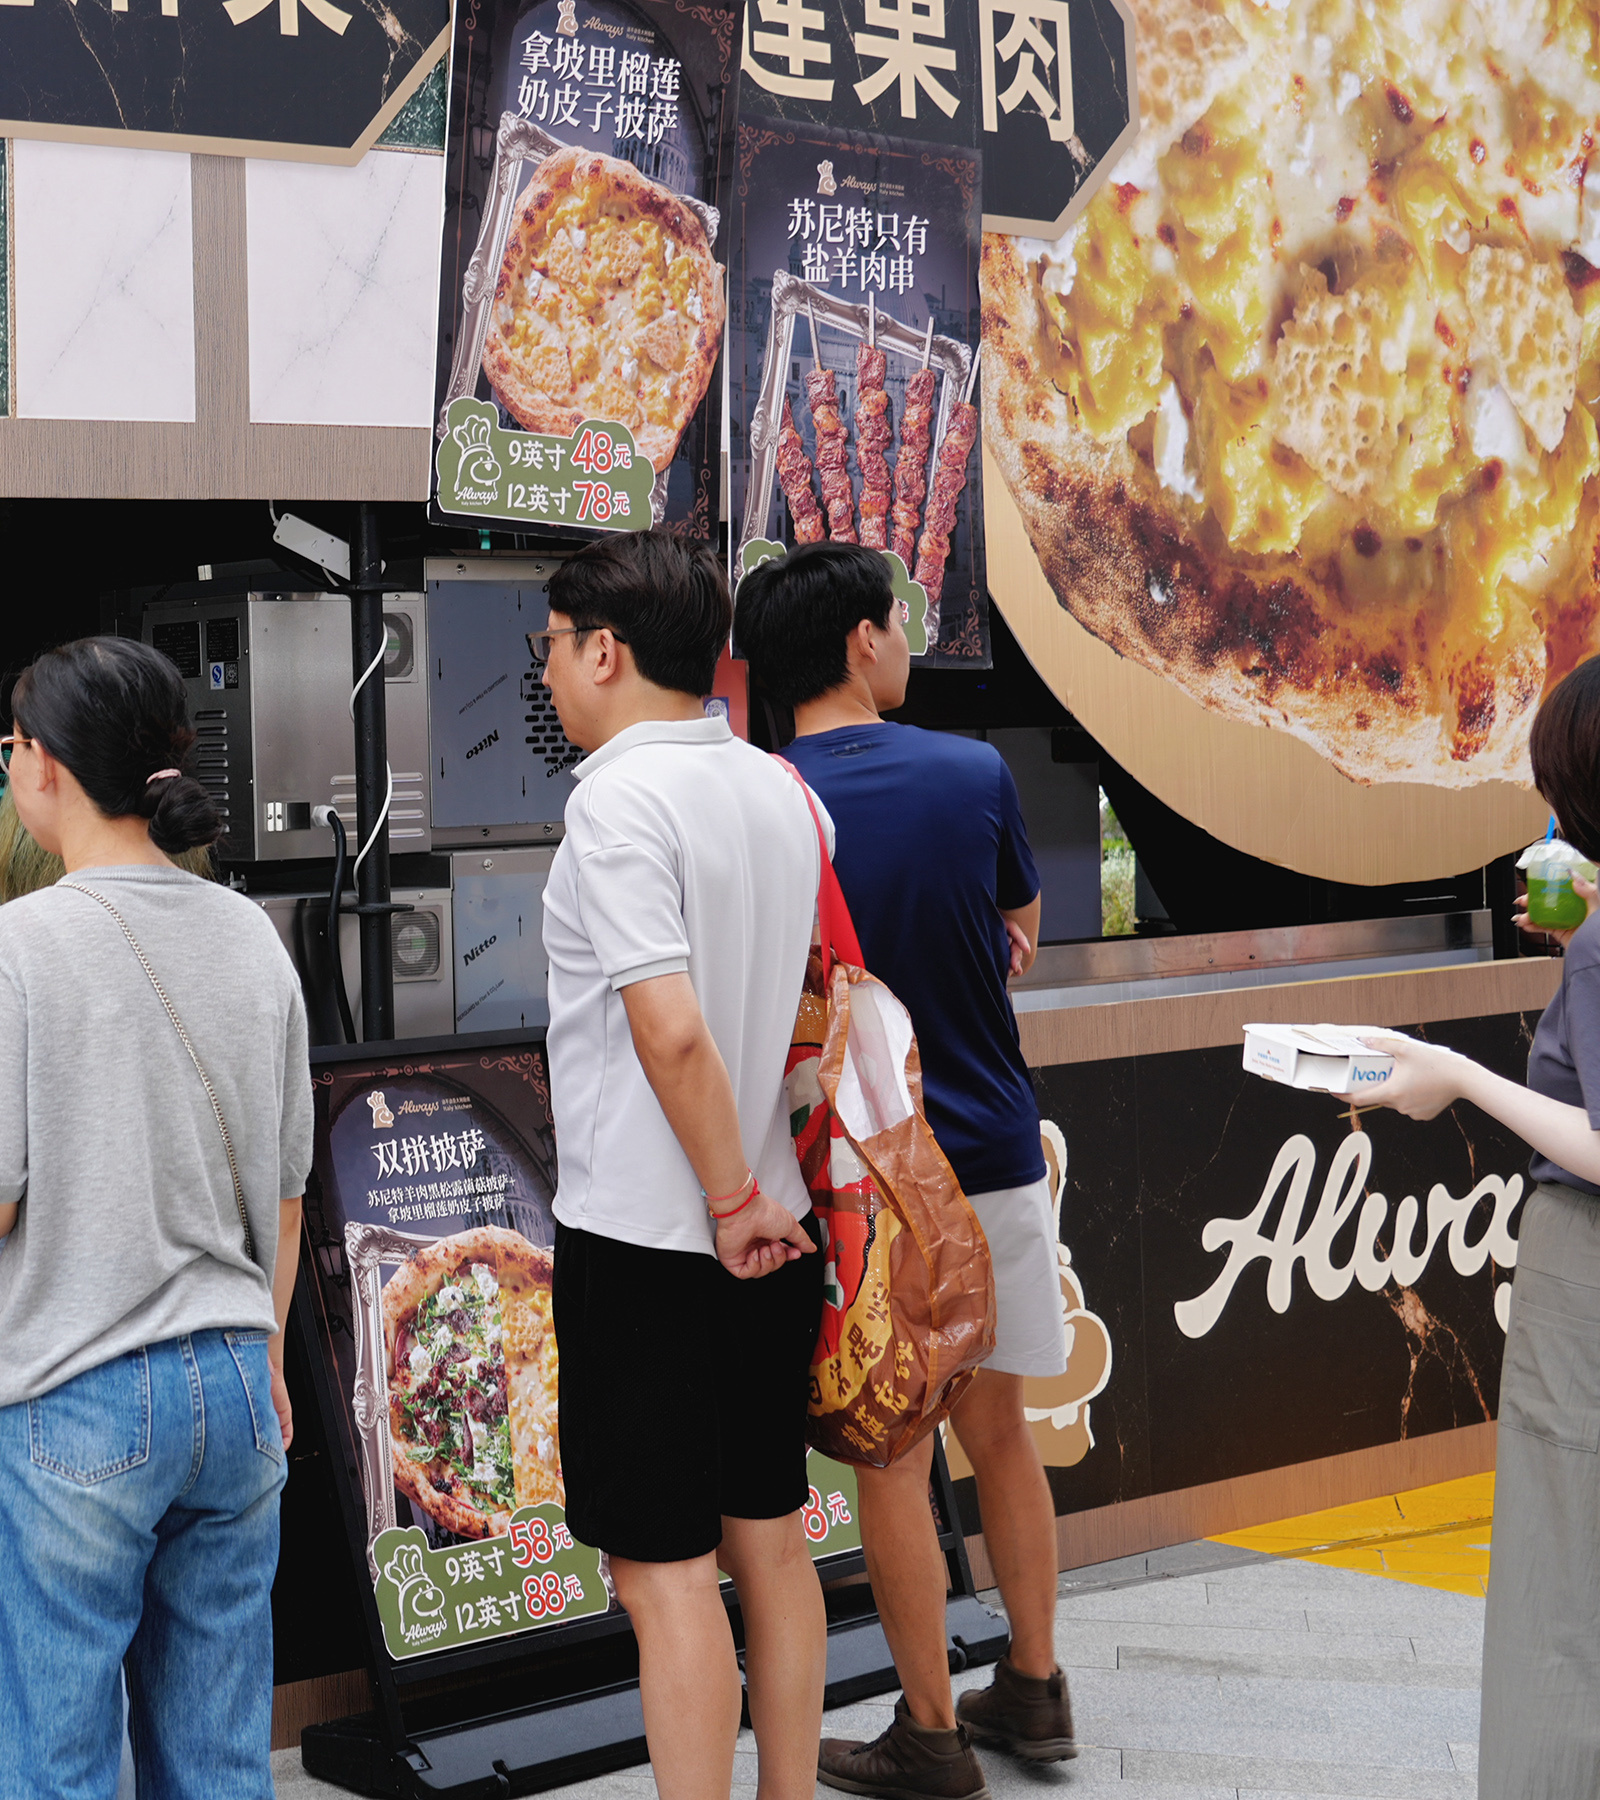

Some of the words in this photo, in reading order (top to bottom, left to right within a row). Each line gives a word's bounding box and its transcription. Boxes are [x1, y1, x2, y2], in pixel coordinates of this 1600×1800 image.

[582, 15, 624, 39] Always
[520, 29, 682, 101] 拿坡里榴莲
[517, 74, 679, 145] 奶皮子披萨
[840, 175, 877, 195] Always
[787, 197, 930, 256] 苏尼特只有
[801, 243, 915, 296] 盐羊肉串
[455, 486, 498, 506] Always
[465, 729, 500, 760] Nitto
[463, 935, 497, 967] Nitto
[398, 1100, 439, 1117] Always
[370, 1128, 486, 1181] 双拼披萨
[1174, 1131, 1524, 1339] Alwa
[404, 1619, 448, 1643] Always
